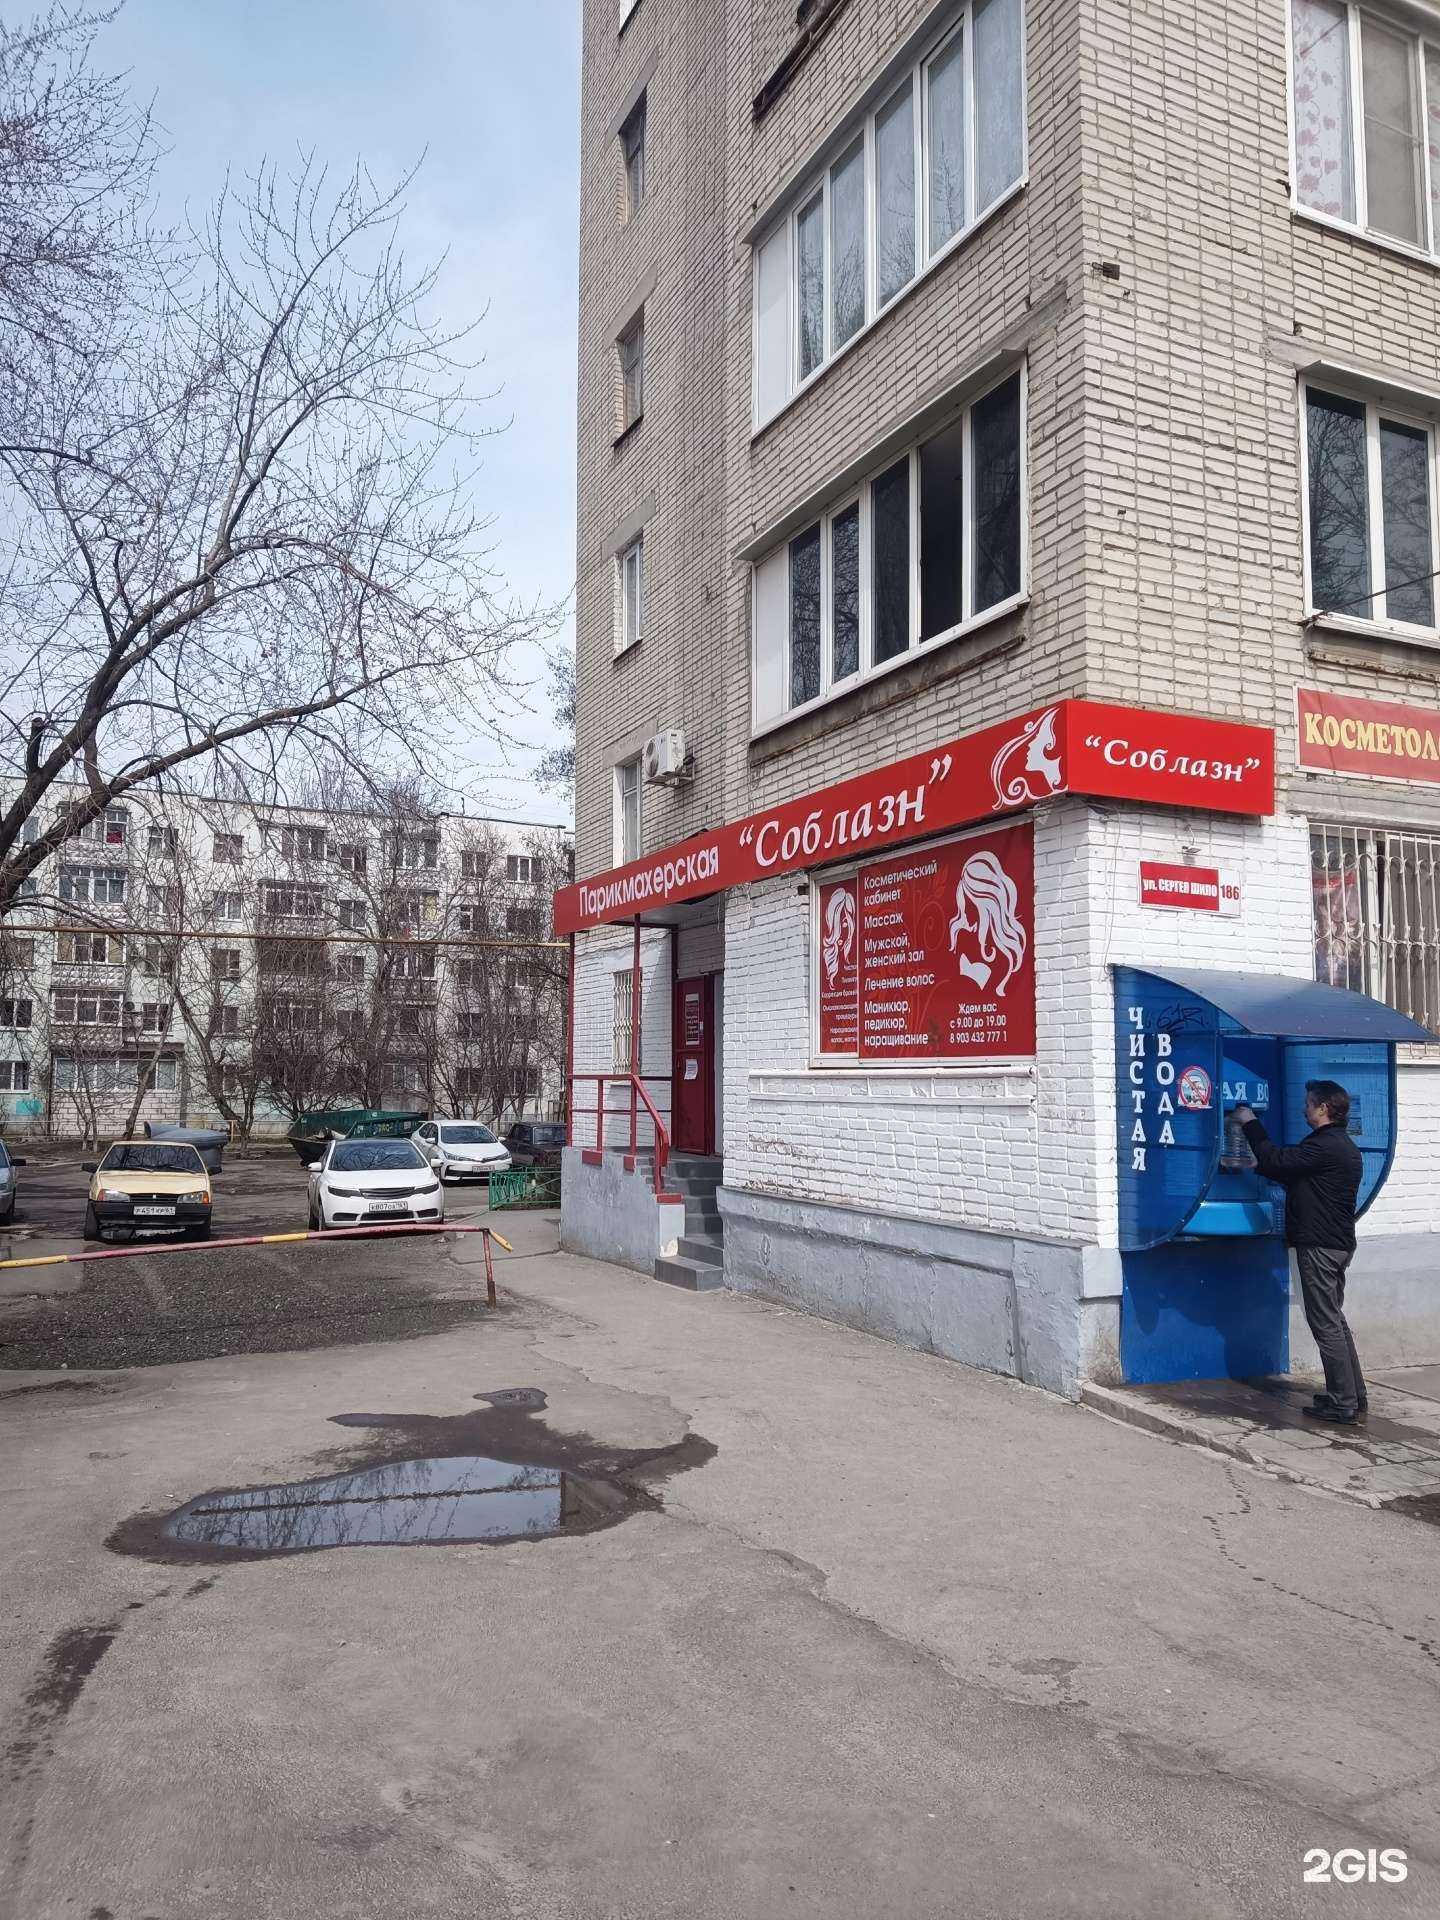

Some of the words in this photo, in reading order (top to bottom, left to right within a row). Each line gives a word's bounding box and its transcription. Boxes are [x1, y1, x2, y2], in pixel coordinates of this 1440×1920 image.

[1304, 712, 1440, 761] КОСМЕТОЛ
[579, 845, 720, 917] Парикмахерская
[864, 861, 938, 890] Косметический
[864, 890, 901, 906] кабинет
[1190, 882, 1218, 897] ШИЛО
[1220, 884, 1240, 900] 186
[864, 912, 904, 929] Массаж
[864, 933, 911, 953] Мужской,
[864, 952, 906, 968] женский
[907, 951, 925, 962] зал
[864, 977, 904, 991] Лечение
[906, 974, 935, 986] волос
[864, 1001, 911, 1014] Маникюр,
[958, 1003, 981, 1015] Ждем
[982, 1003, 998, 1013] вас
[864, 1018, 908, 1031] педикюр,
[949, 1020, 956, 1028] с
[956, 1016, 973, 1028] 9.00
[974, 1018, 984, 1029] до
[985, 1015, 1007, 1027] 19.00
[864, 1033, 929, 1049] наращивание
[949, 1034, 955, 1044] 8
[955, 1033, 969, 1044] 903
[970, 1032, 985, 1043] 432
[987, 1031, 1001, 1042] 777
[1128, 1007, 1146, 1171] ЧИСТАЯ
[1156, 1033, 1175, 1144] ВОДА
